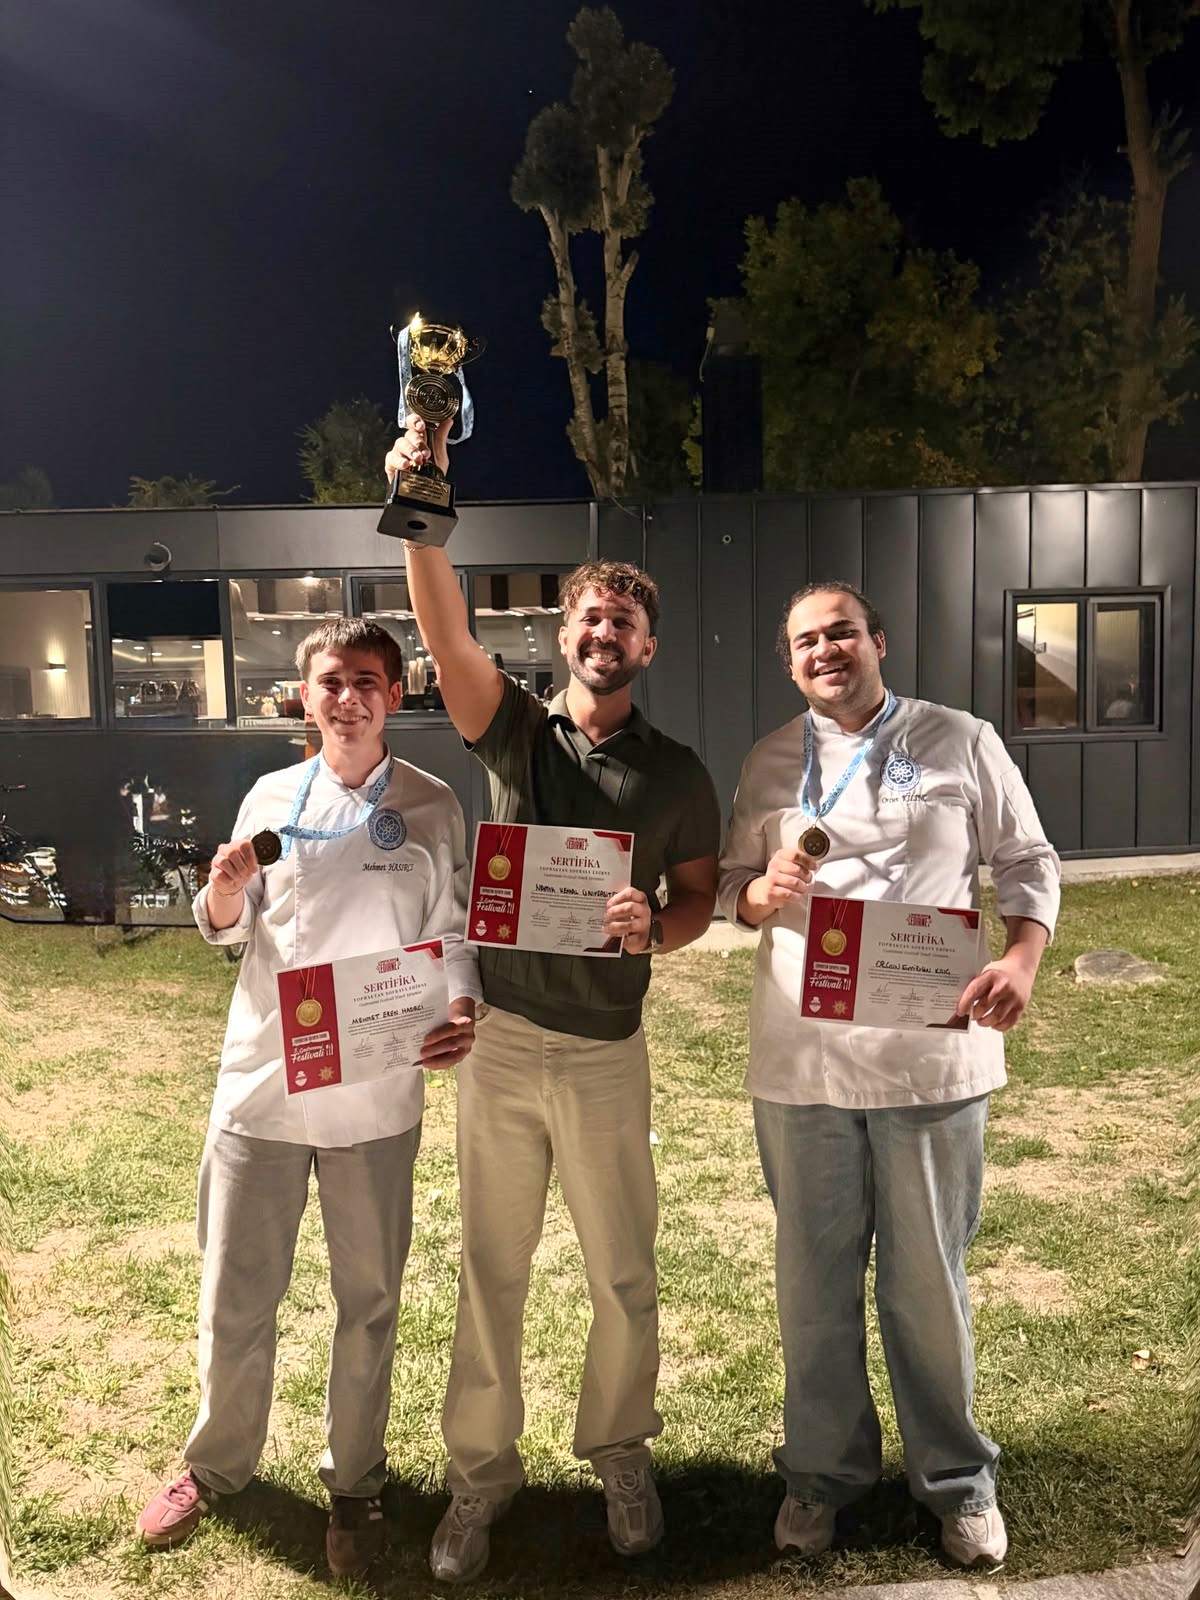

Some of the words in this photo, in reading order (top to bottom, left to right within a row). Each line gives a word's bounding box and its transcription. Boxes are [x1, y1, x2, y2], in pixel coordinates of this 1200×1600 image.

[550, 856, 601, 868] SERTİFİKA
[476, 901, 507, 913] Festivali
[890, 932, 945, 946] SERTİFİKA
[363, 975, 416, 994] SERTİFİKA
[809, 977, 843, 990] Festivali
[382, 1009, 399, 1019] EREN
[290, 1048, 325, 1064] Festivali
